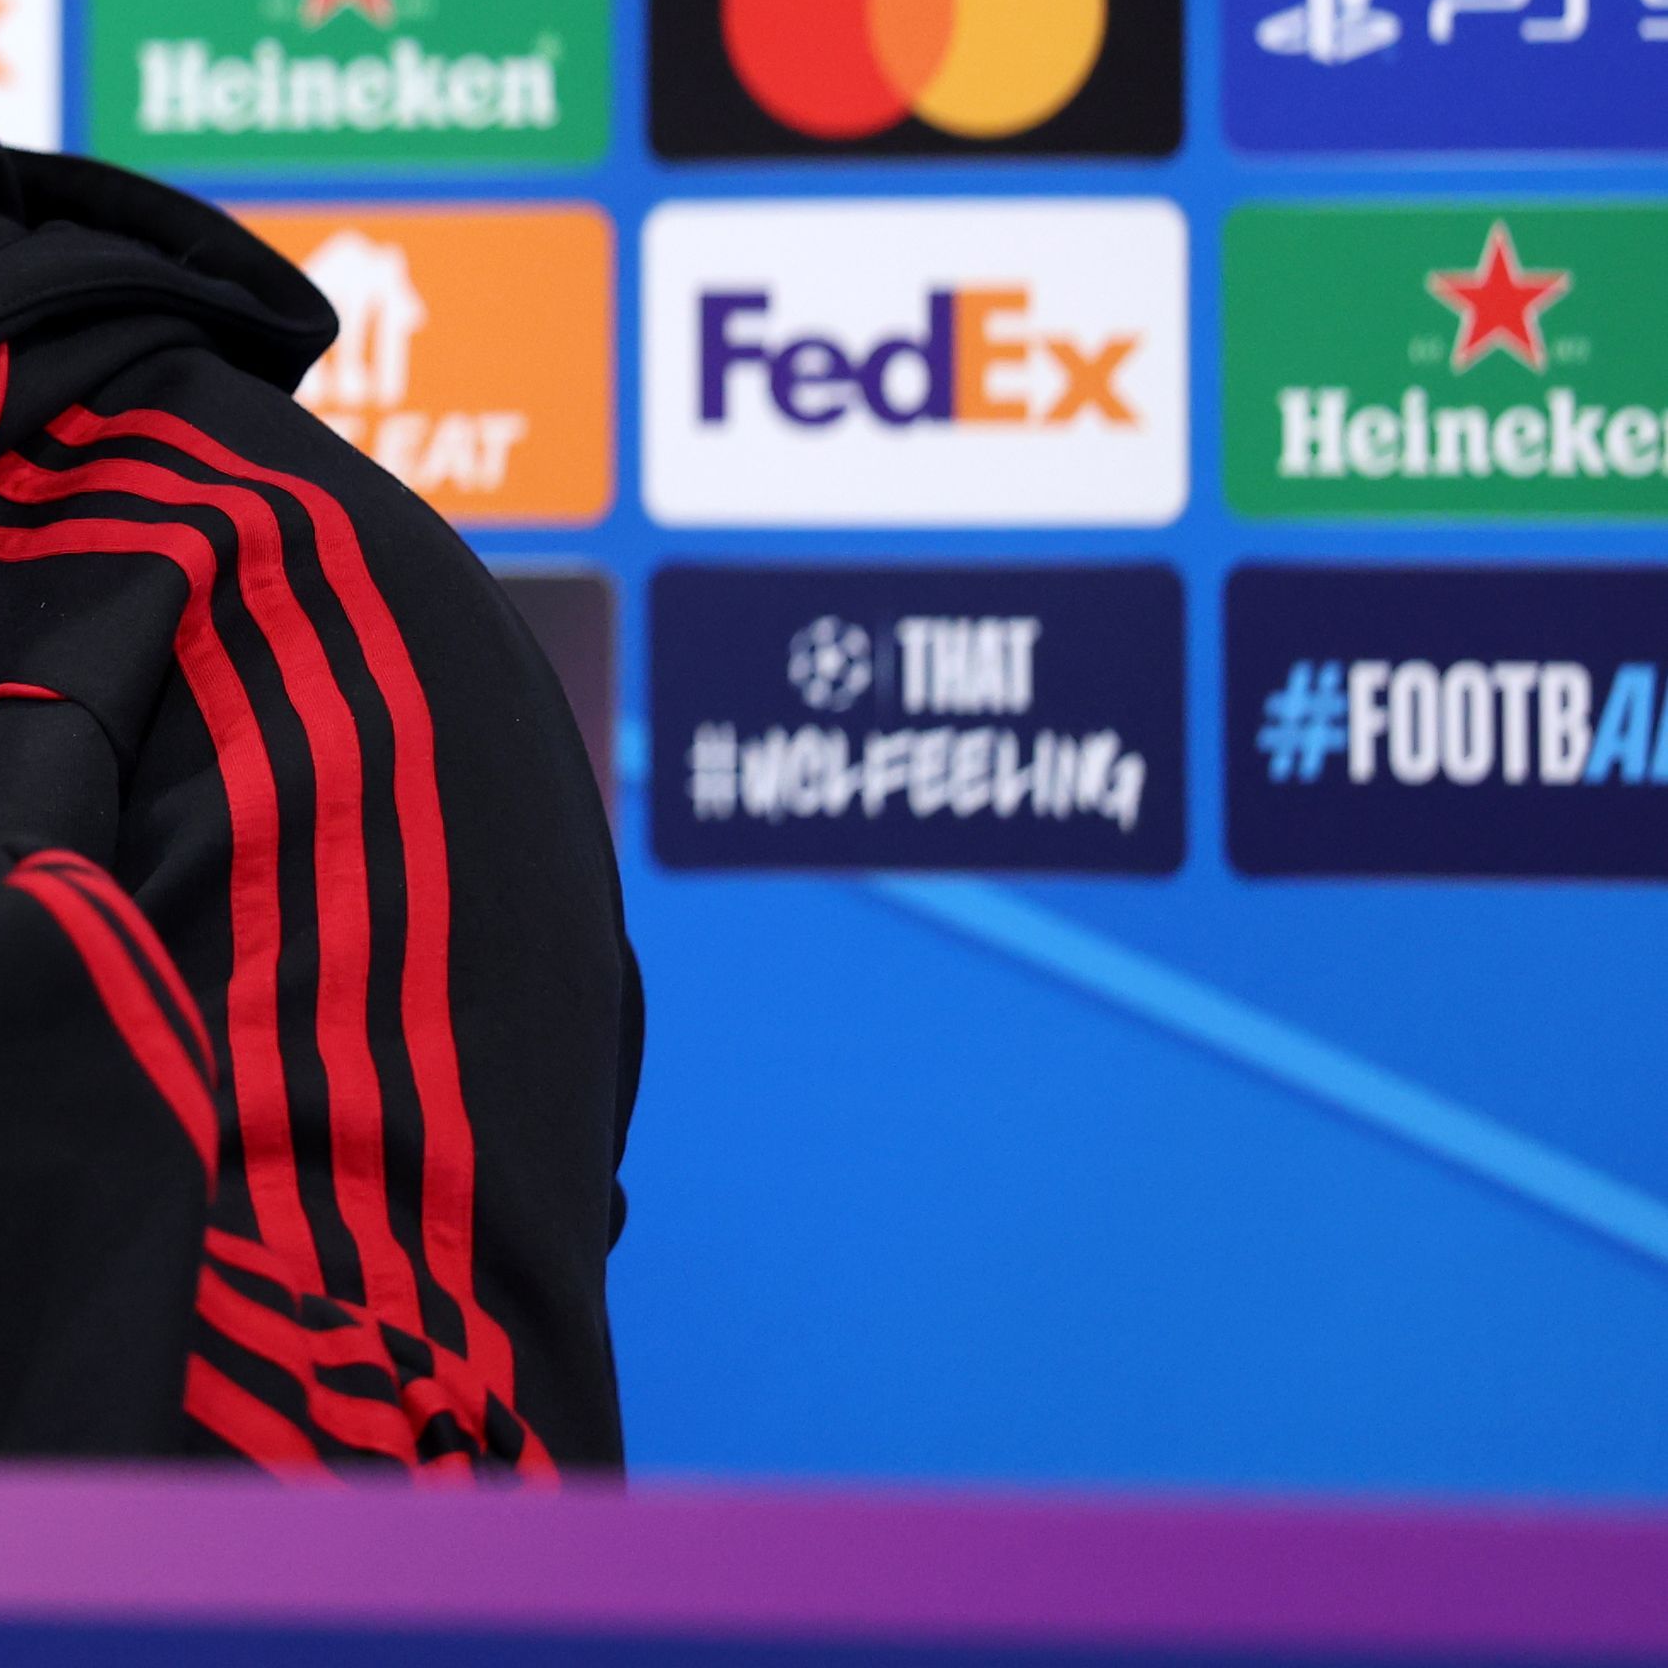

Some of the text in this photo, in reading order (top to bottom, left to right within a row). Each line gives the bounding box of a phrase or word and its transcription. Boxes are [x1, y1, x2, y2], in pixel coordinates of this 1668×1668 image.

[139, 38, 559, 134] Heineken
[696, 278, 1144, 432] FedEx
[1279, 384, 1668, 480] Heineke
[896, 615, 1042, 714] THAT
[1256, 657, 1668, 787] #FOOTBA
